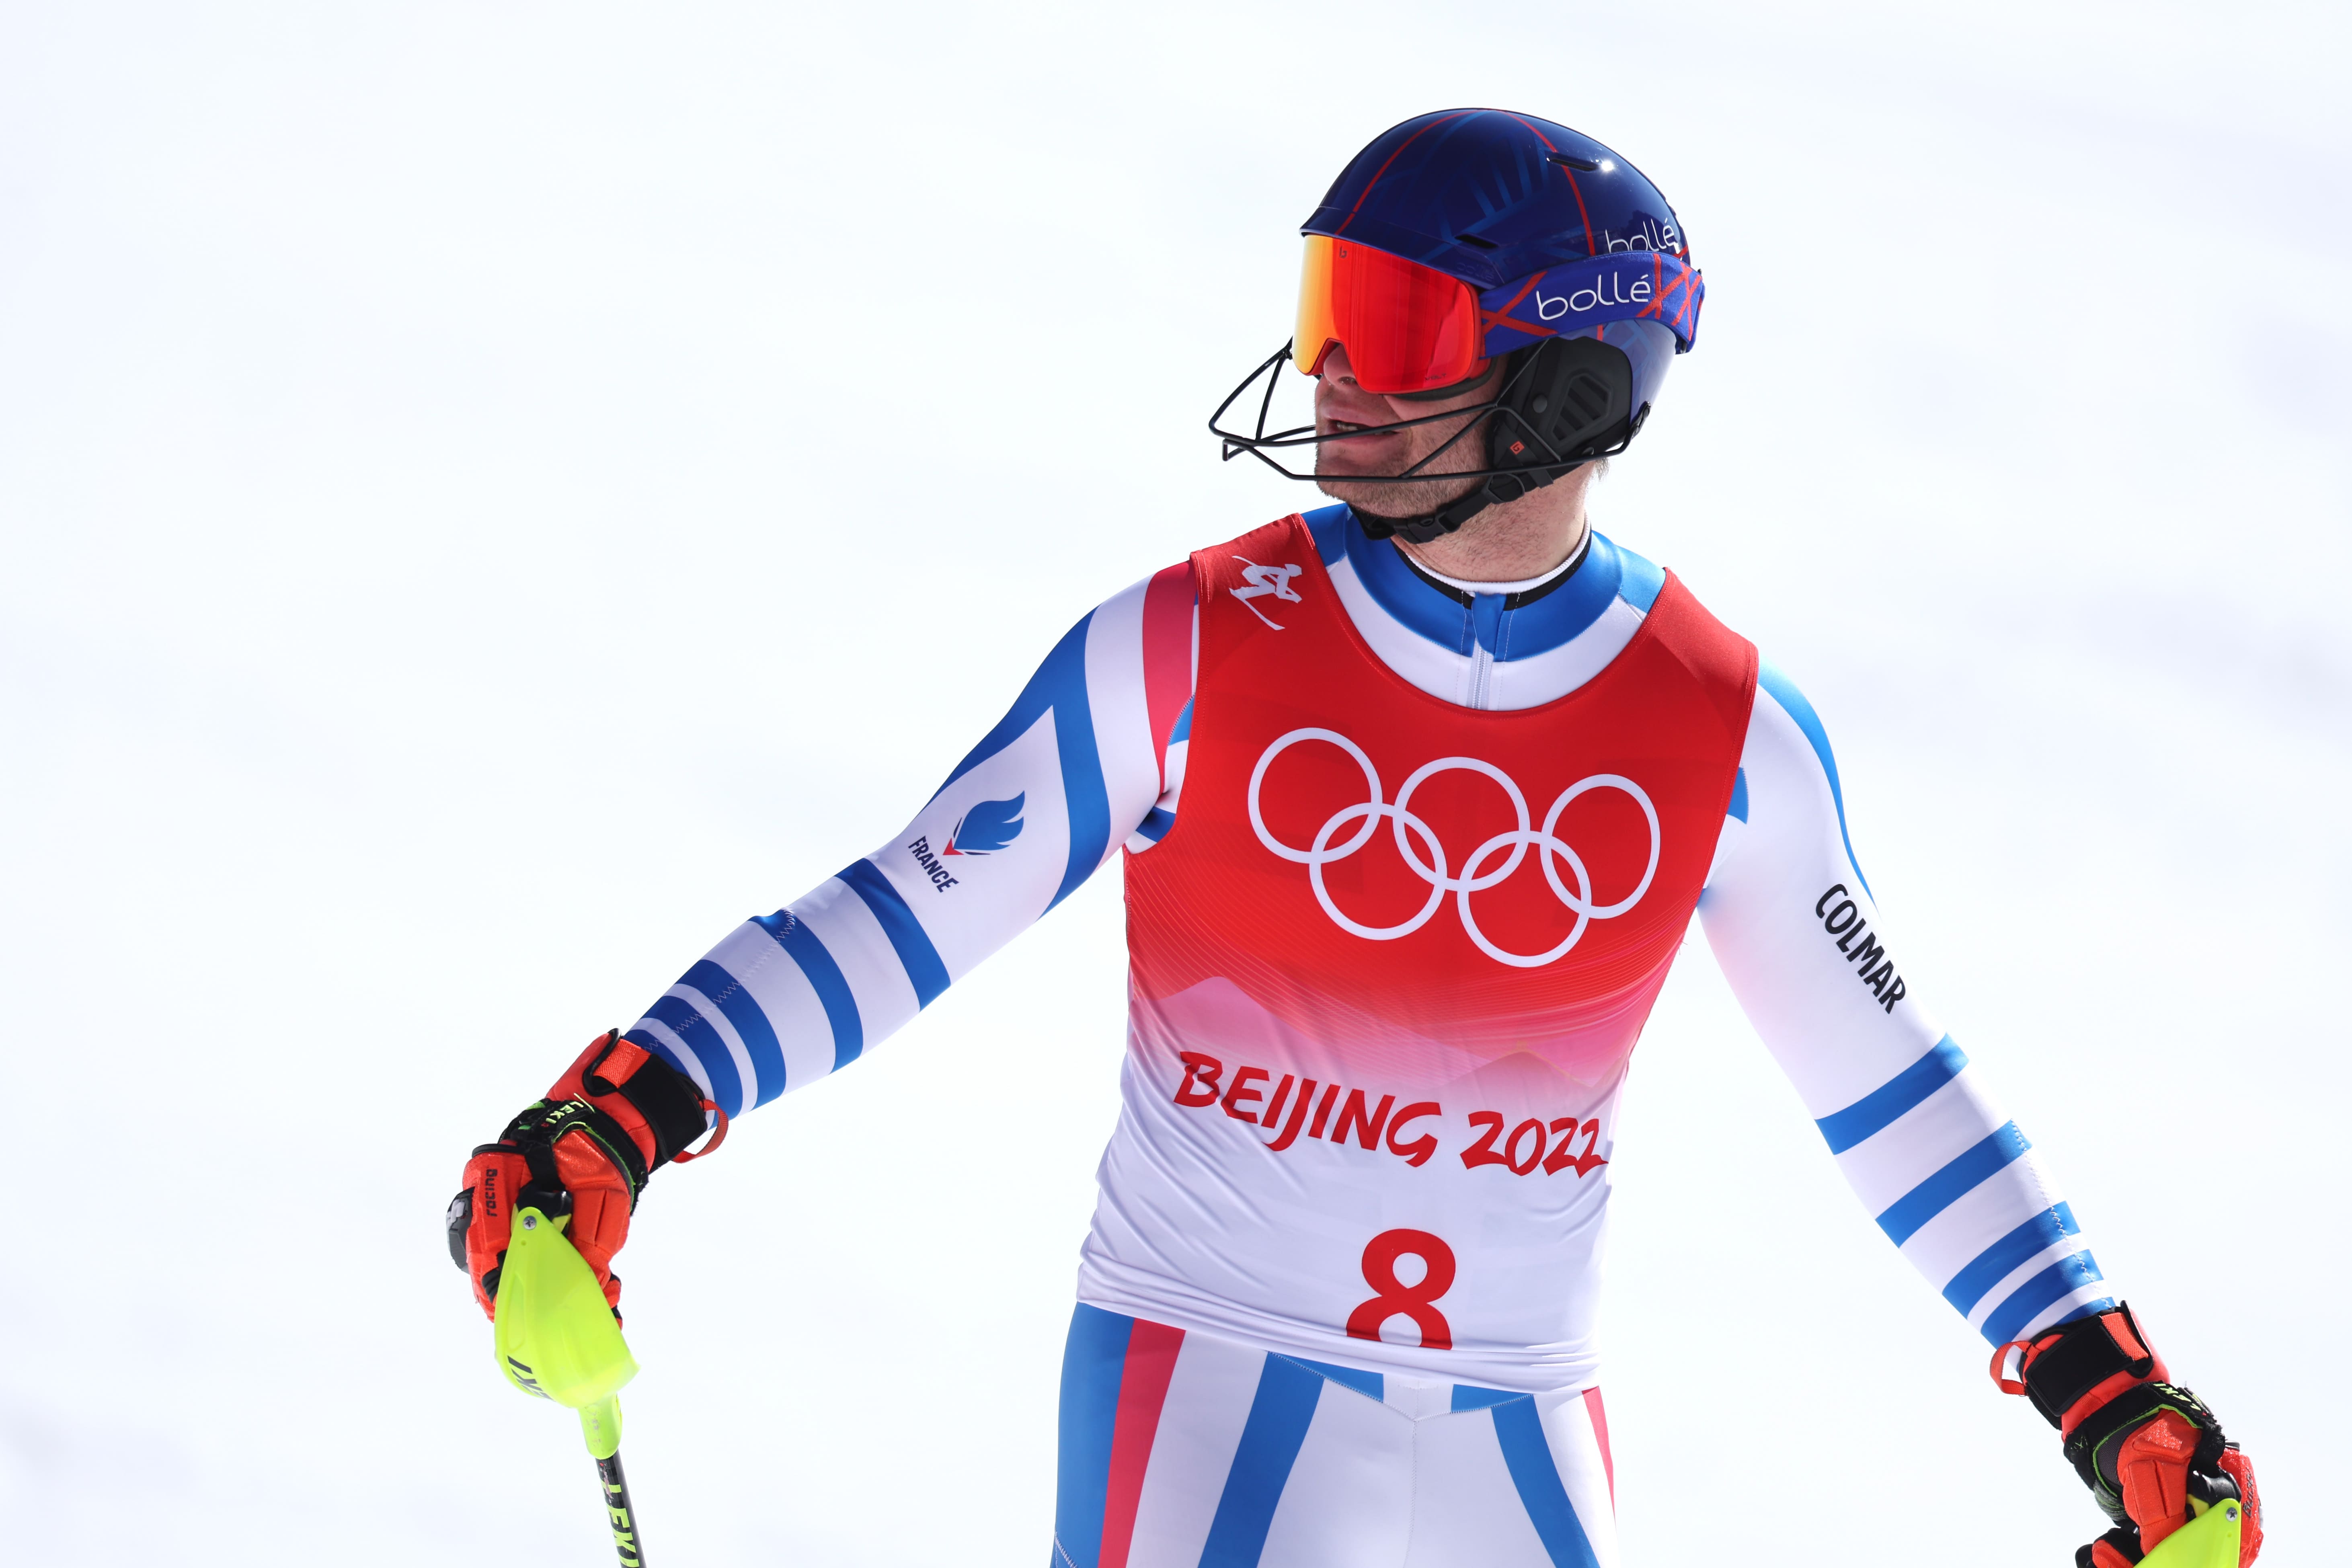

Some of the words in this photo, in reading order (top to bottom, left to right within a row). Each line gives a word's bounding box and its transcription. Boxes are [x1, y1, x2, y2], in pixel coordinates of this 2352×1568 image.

[1536, 271, 1650, 320] bollé
[908, 835, 959, 893] FRANCE
[1816, 884, 1906, 1014] COLMAR
[546, 1101, 584, 1124] LEKI
[1173, 1051, 1442, 1168] BEIJING
[1460, 1110, 1608, 1178] 2022
[485, 1168, 498, 1217] racing
[1346, 1228, 1456, 1350] 8
[601, 1478, 640, 1568] LEKI
